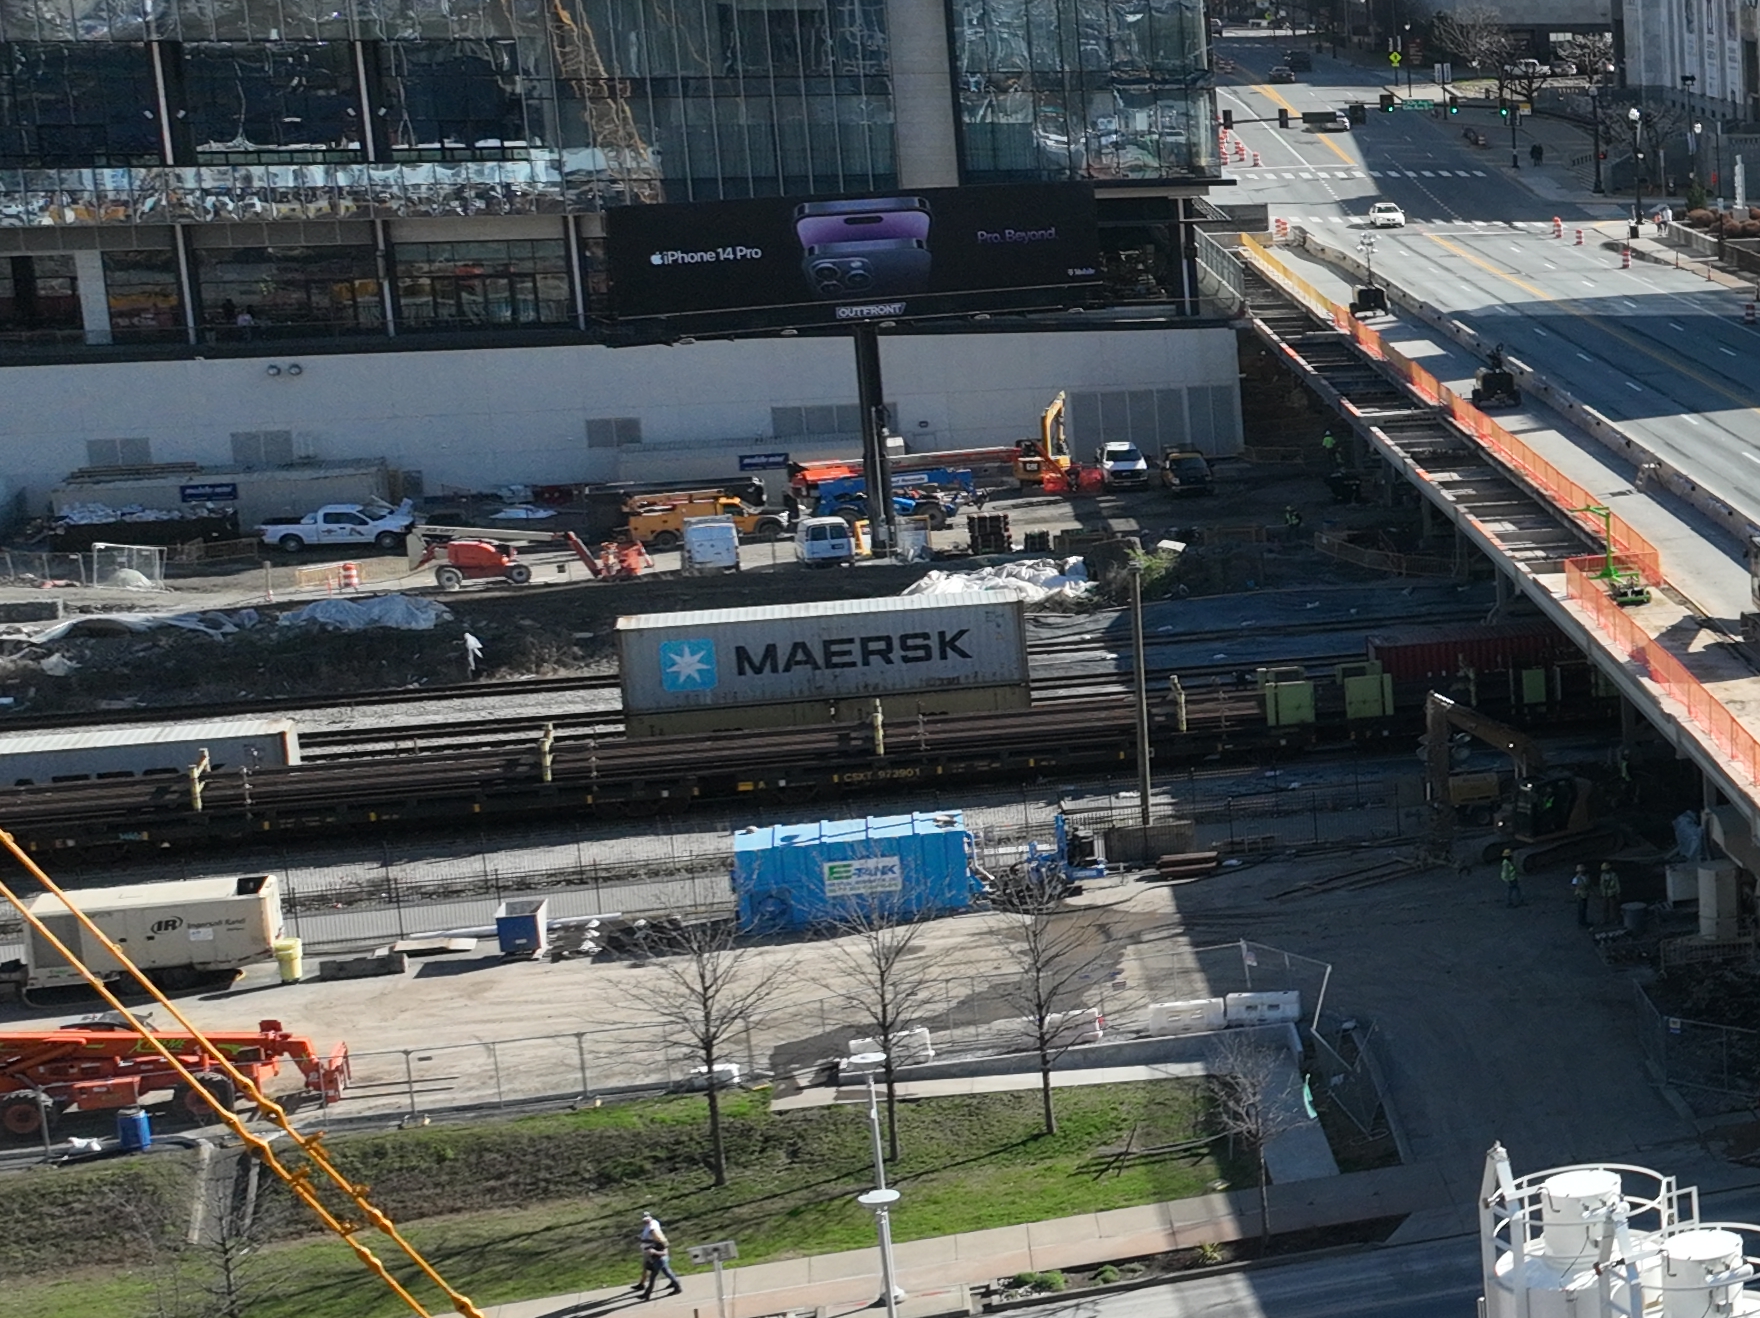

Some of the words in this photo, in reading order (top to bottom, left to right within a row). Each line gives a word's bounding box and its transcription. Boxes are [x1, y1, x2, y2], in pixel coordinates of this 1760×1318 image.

[663, 247, 717, 266] iPhone
[718, 247, 734, 262] 14
[736, 245, 762, 260] Pro
[838, 302, 902, 318] OUTFRONT
[734, 628, 973, 677] MAERSK
